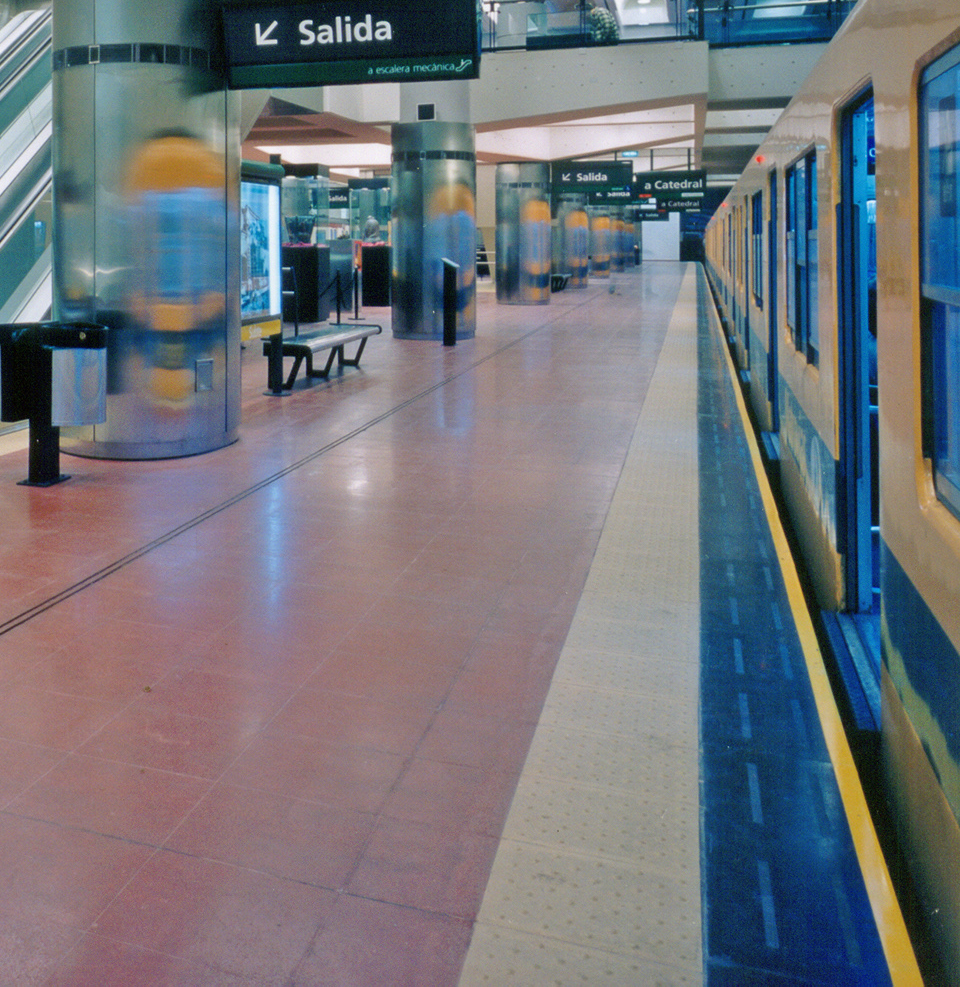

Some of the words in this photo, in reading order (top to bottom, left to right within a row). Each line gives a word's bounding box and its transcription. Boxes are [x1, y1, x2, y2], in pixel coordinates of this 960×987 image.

[298, 14, 392, 45] Salida
[368, 67, 373, 75] a
[376, 64, 410, 75] escalera
[576, 172, 608, 182] Salida
[644, 182, 651, 190] a
[654, 178, 703, 190] Catedral
